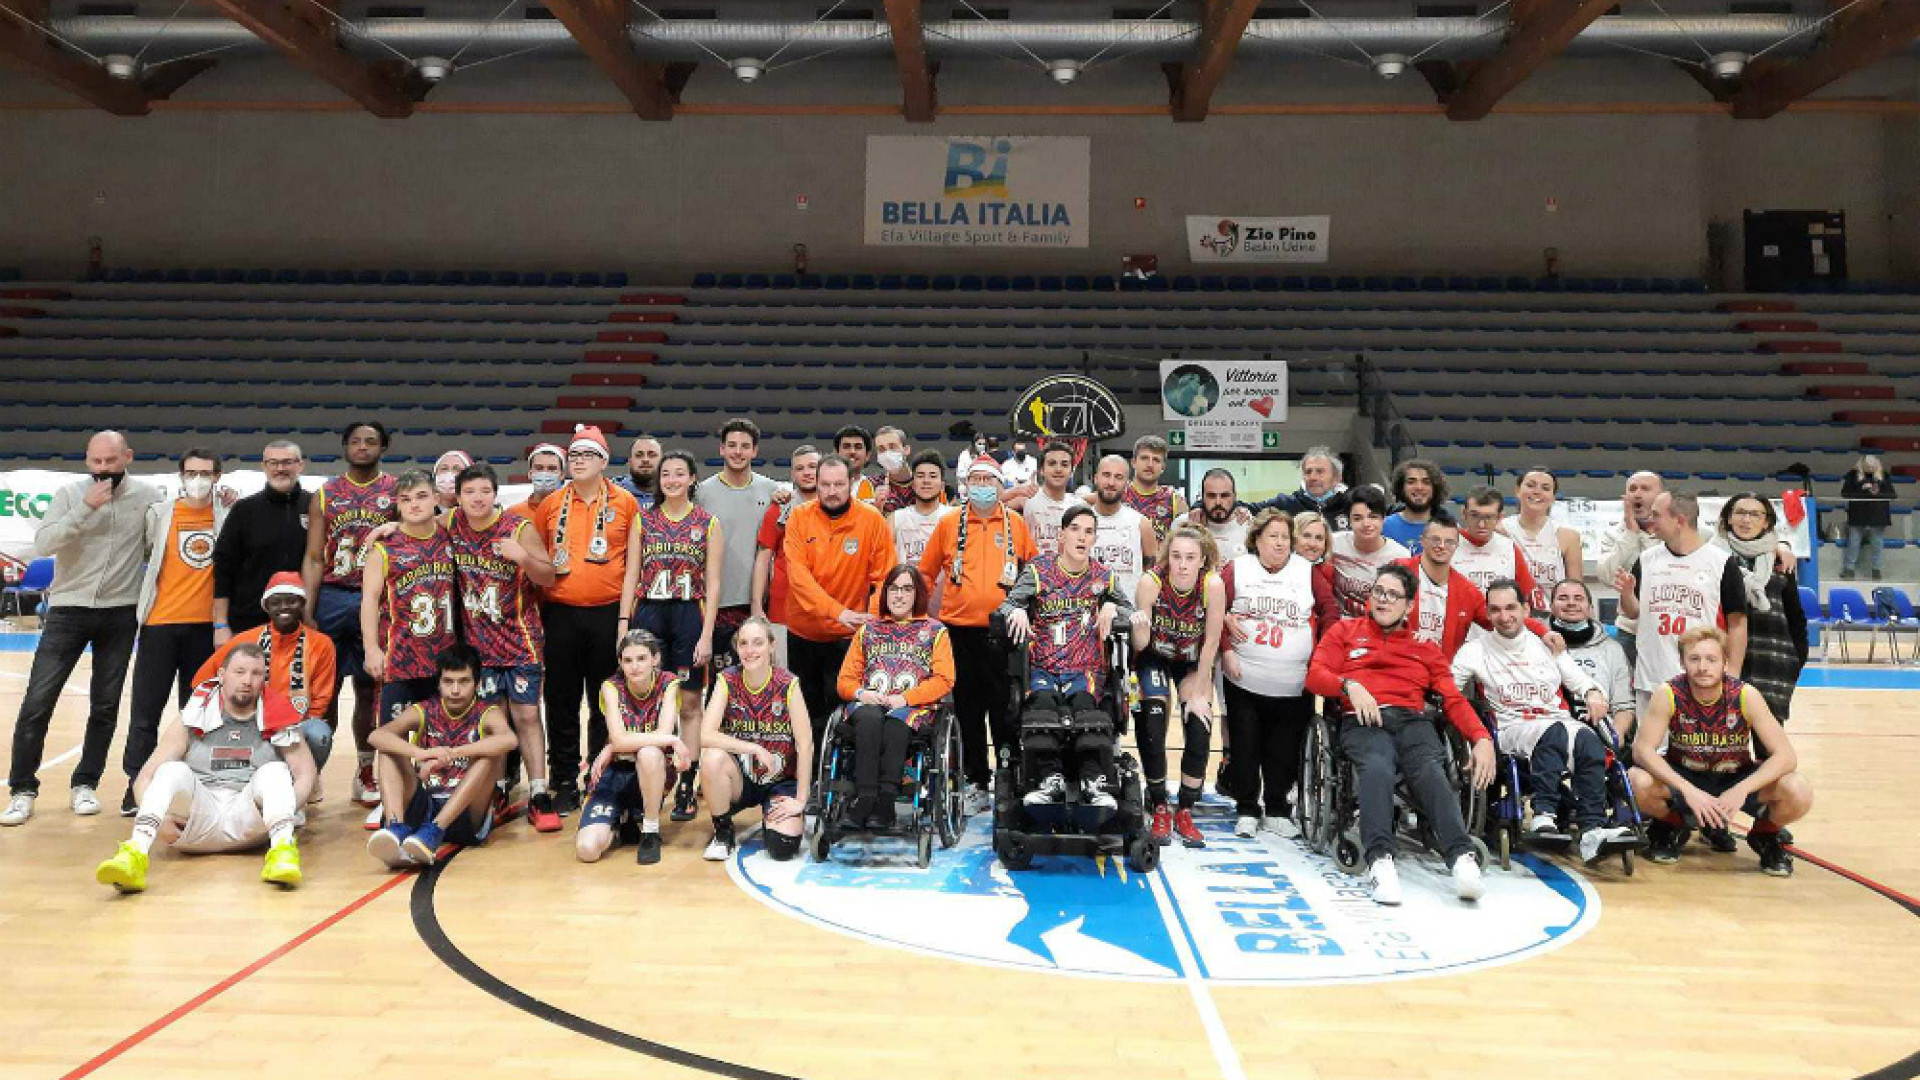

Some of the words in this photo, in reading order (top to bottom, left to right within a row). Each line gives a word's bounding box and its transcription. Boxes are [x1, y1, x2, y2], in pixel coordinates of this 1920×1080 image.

[882, 202, 970, 225] BELLA
[978, 202, 1071, 226] ITALIA
[908, 230, 960, 243] Village
[964, 230, 1002, 245] Sport
[1022, 231, 1070, 245] Family
[1245, 227, 1274, 241] Zio
[1279, 227, 1317, 241] Pino
[1226, 367, 1278, 383] Vittoria
[646, 569, 692, 601] 41
[1648, 584, 1705, 611] LUPO
[410, 590, 454, 637] 31
[1658, 613, 1687, 636] 30
[1254, 621, 1284, 649] 20
